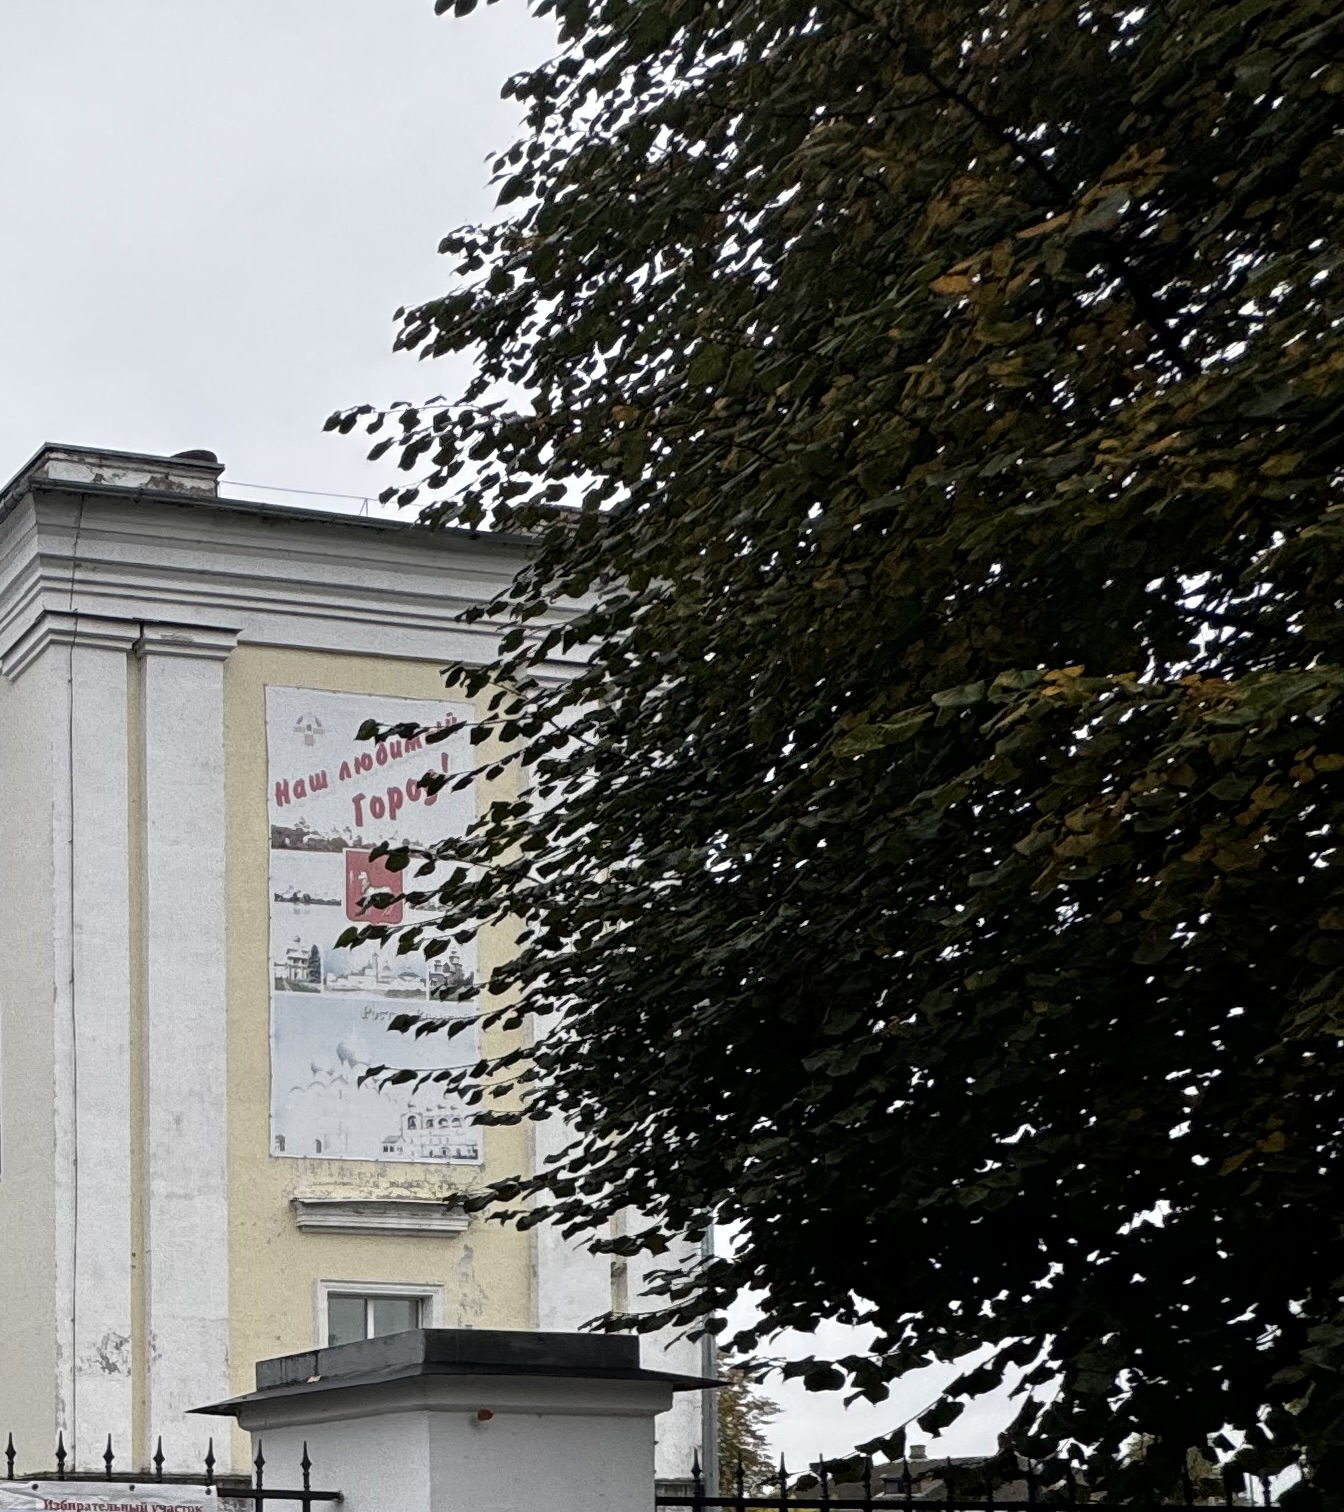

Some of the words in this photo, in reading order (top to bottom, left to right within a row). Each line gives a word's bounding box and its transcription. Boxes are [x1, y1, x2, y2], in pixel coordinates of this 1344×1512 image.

[275, 769, 328, 807] Наш
[339, 712, 458, 781] любимй
[352, 752, 449, 827] Горо!
